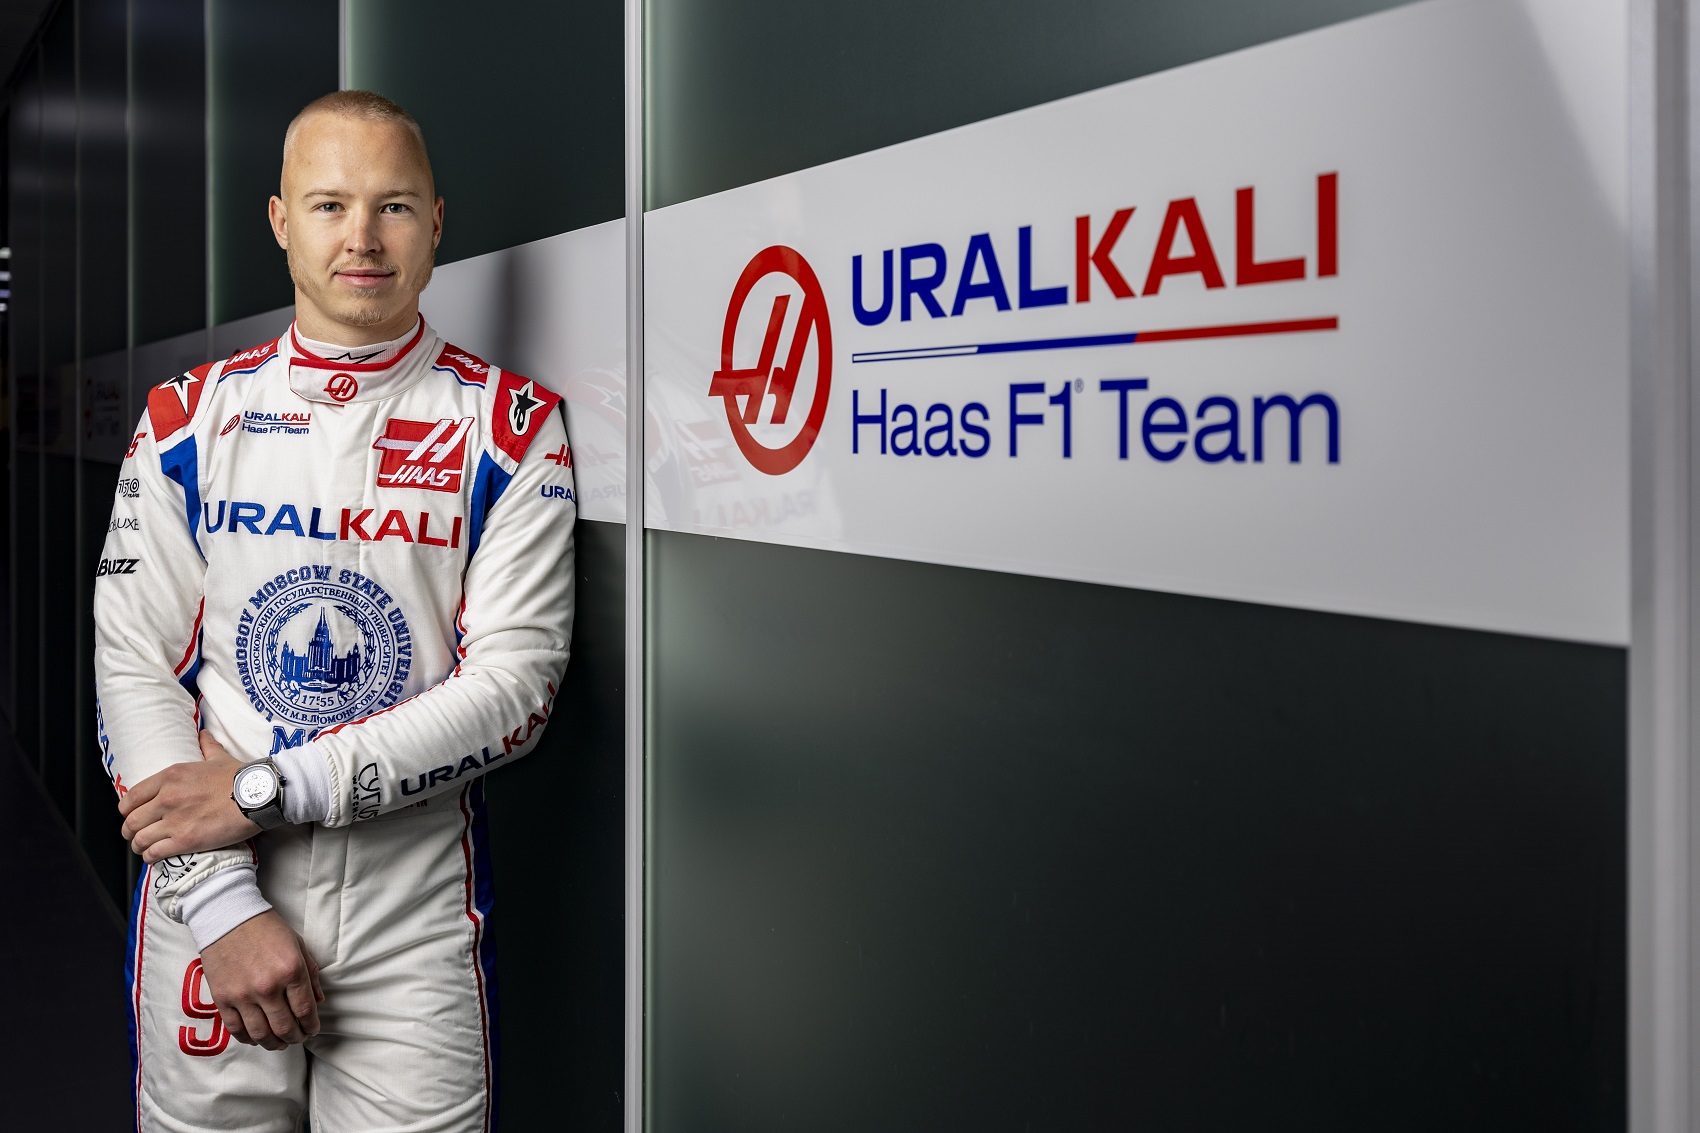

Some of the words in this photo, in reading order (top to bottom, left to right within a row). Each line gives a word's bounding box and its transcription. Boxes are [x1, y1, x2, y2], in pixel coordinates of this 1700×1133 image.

[852, 171, 1339, 327] URALKALI
[244, 410, 311, 422] URALKALI
[852, 389, 991, 459] Haas
[1100, 378, 1341, 465] Team
[242, 423, 268, 434] Haas
[281, 427, 309, 435] Team
[379, 464, 462, 487] HAAS
[203, 500, 463, 549] URALKALI
[96, 558, 140, 577] BUZZ
[249, 565, 332, 611] MOSCOW
[338, 568, 394, 611] STATE
[367, 607, 413, 715] UNIVERSIT
[301, 694, 335, 708] 1755
